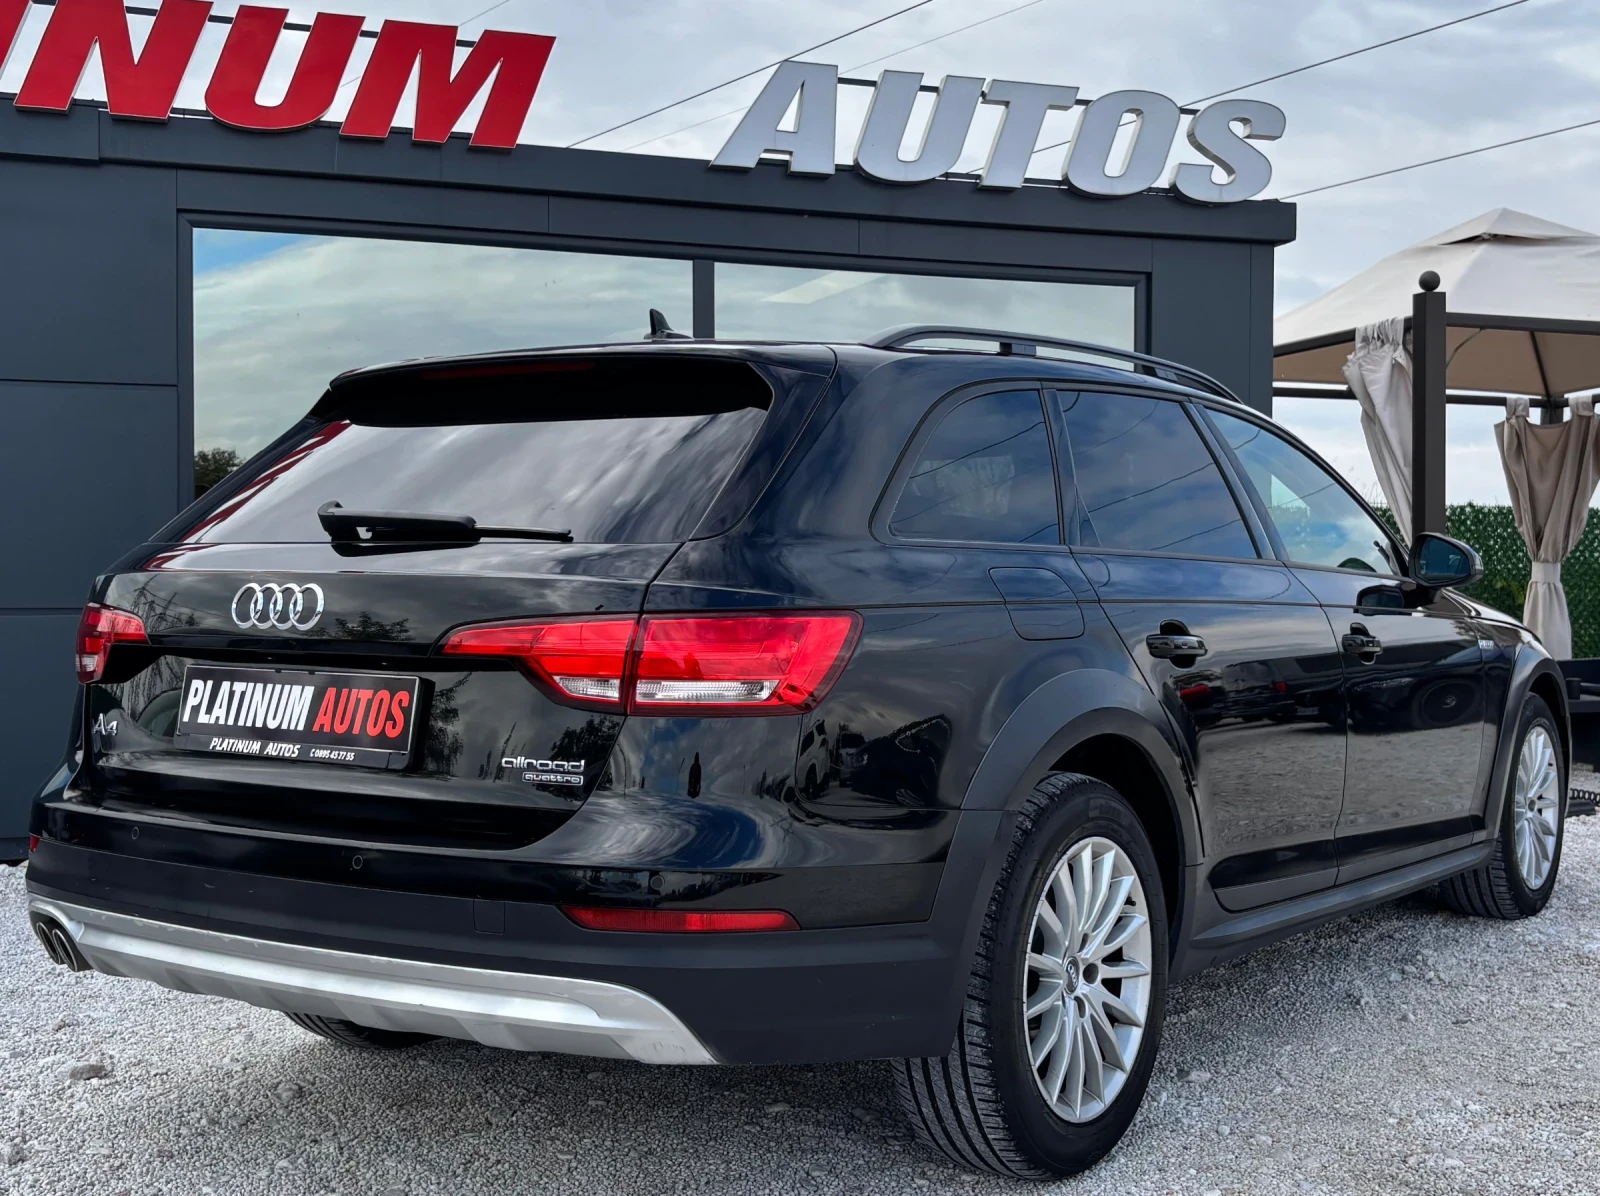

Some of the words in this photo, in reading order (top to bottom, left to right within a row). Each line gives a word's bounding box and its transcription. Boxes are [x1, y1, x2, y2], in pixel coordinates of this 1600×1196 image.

[0, 0, 557, 150] NUM
[709, 60, 1286, 204] AUTOS
[182, 679, 315, 731] PLATINUM
[312, 687, 410, 738] AUTOS
[92, 713, 118, 736] A4
[209, 737, 261, 754] PLATINUM
[263, 742, 301, 757] AUTOS
[501, 756, 585, 773] allroad
[524, 773, 580, 784] quattro
